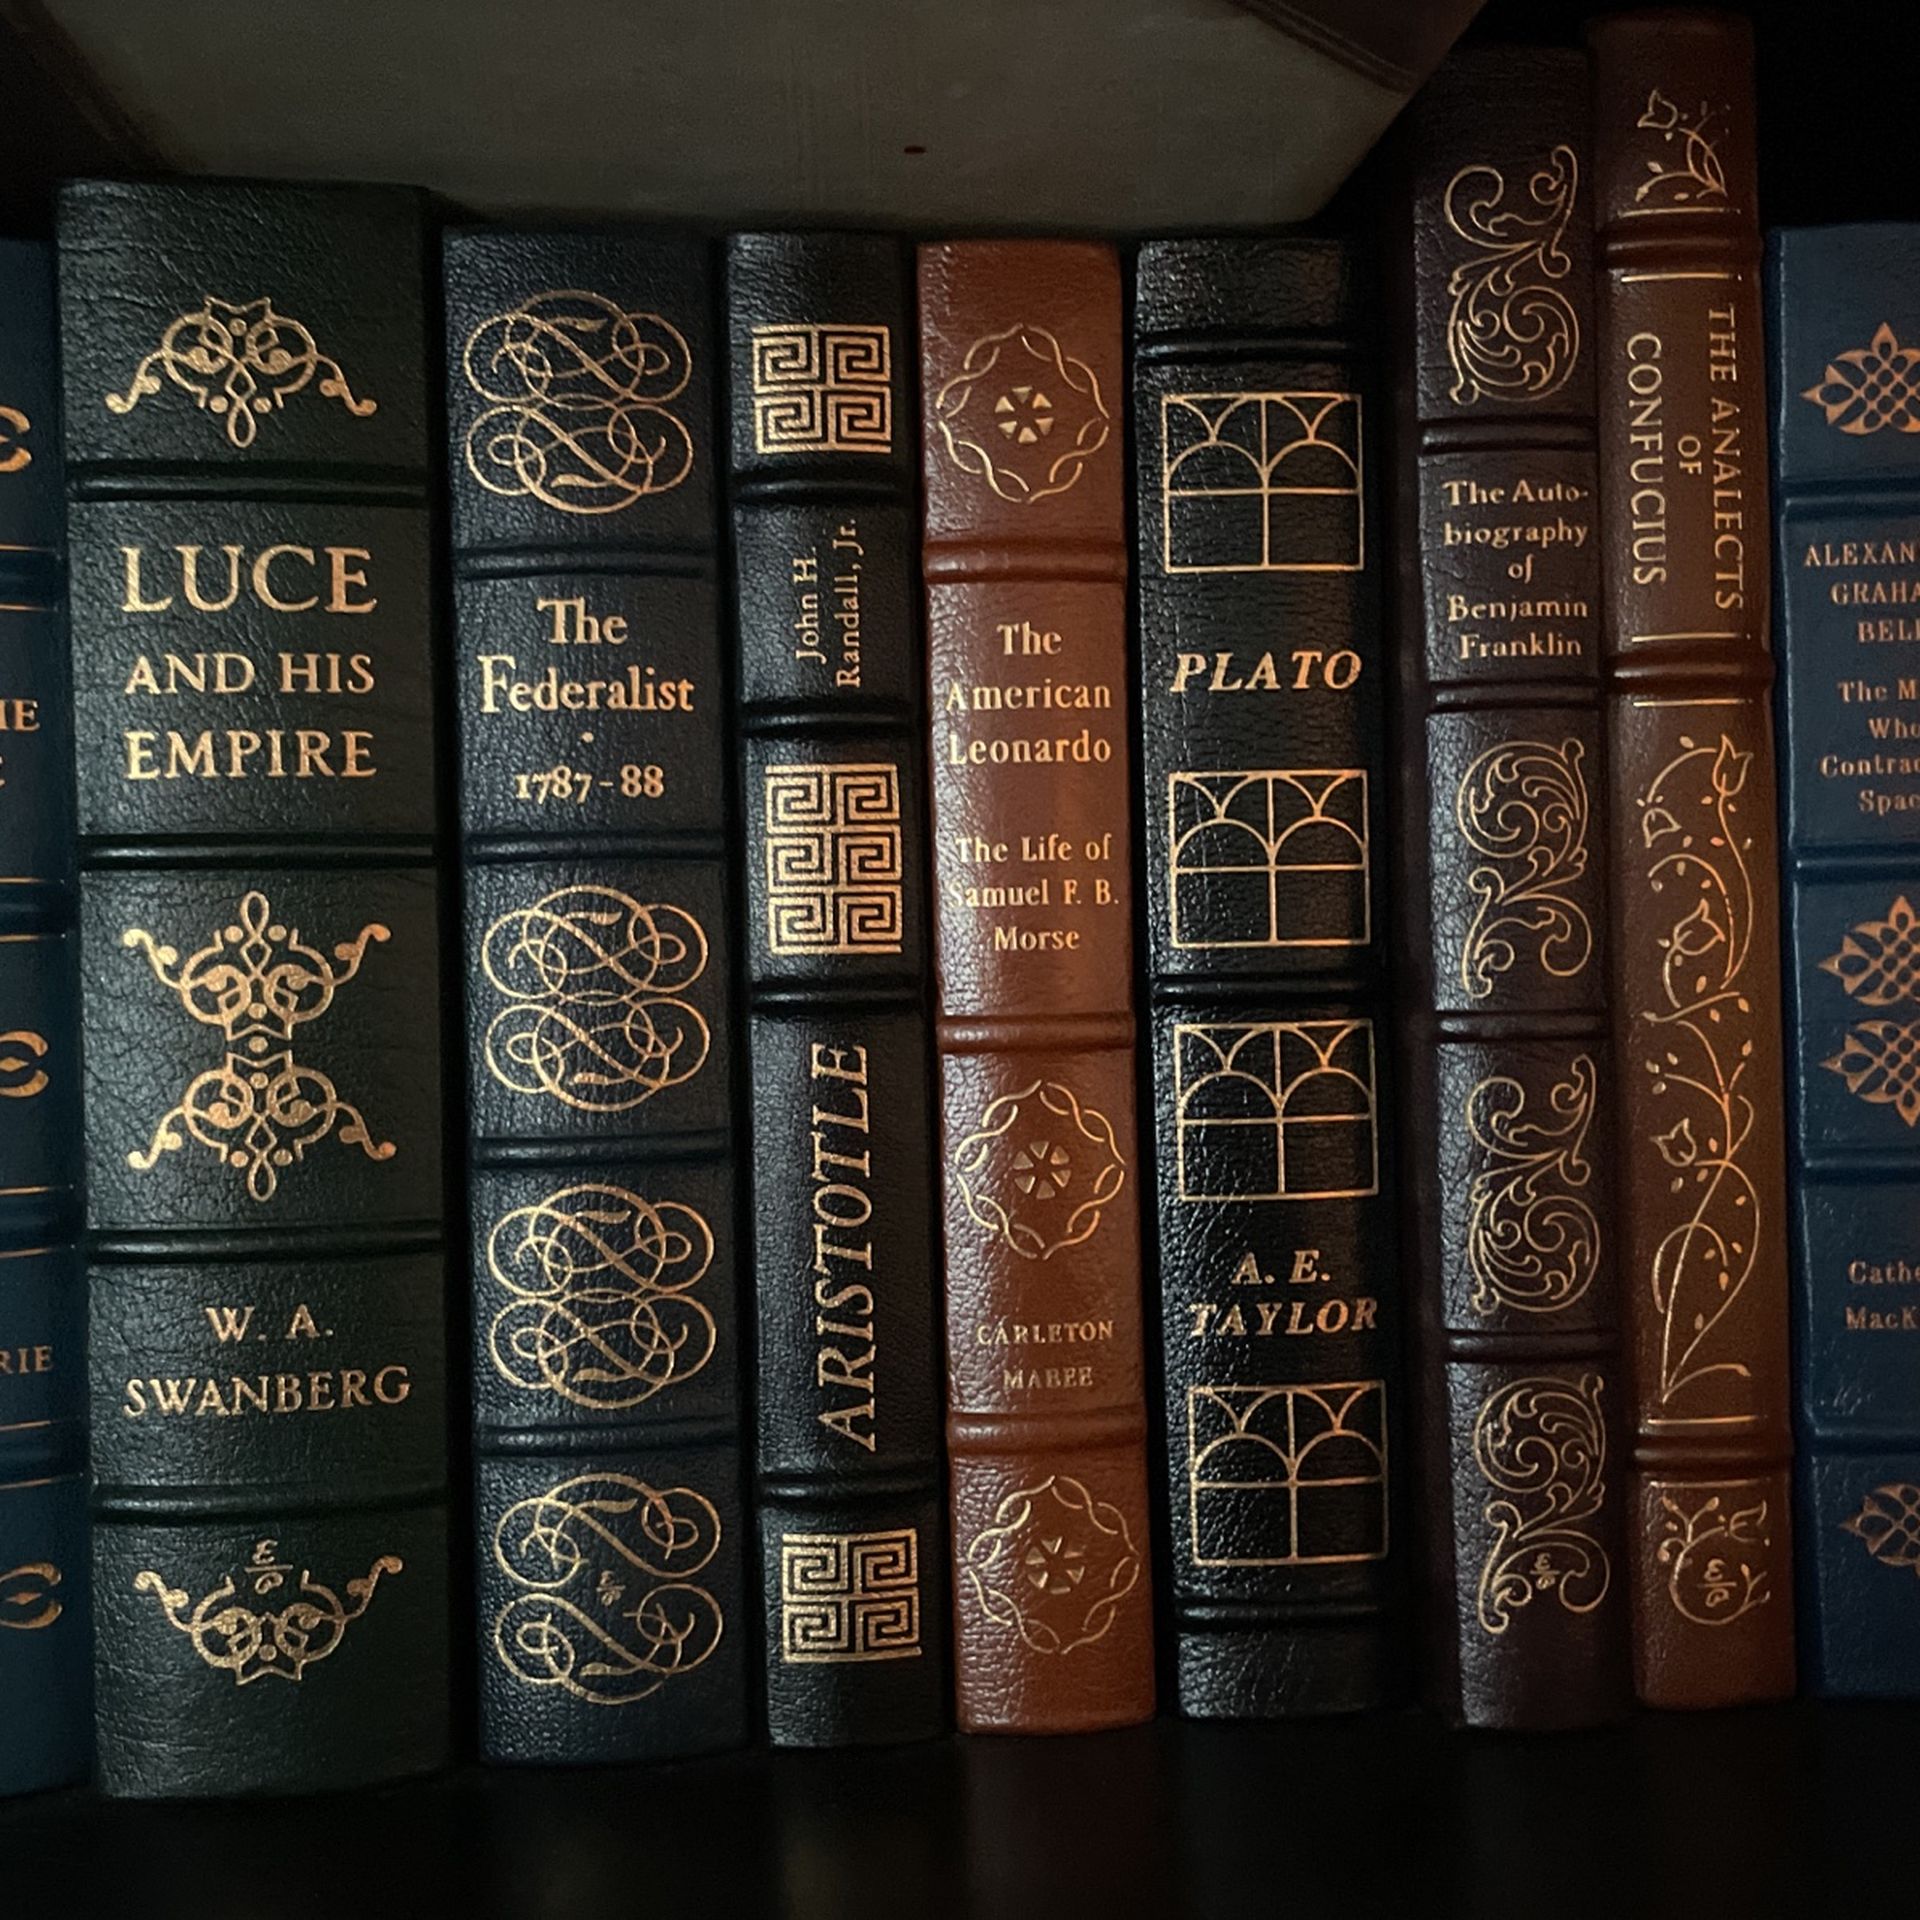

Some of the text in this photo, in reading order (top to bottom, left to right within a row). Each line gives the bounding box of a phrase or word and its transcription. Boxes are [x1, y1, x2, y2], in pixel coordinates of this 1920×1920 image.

[1626, 332, 1667, 586] CONFUCIUS
[1677, 434, 1702, 475] OF
[1708, 306, 1744, 611] THE ANALECTS
[1441, 479, 1589, 506] The Auto-
[1443, 517, 1588, 549] biography
[121, 544, 378, 613] LUCE
[1507, 553, 1534, 584] of
[536, 596, 628, 645] The
[792, 547, 827, 665] John H.
[832, 518, 865, 688] Randall, Jr.
[1447, 594, 1588, 623] Benjamin
[997, 622, 1062, 656] The
[1459, 631, 1583, 660] Franklin
[123, 653, 375, 695] AND HIS
[476, 654, 695, 714] Federalist
[1168, 650, 1363, 693] PLATO
[1837, 678, 1888, 703] The
[945, 678, 1112, 713] American
[122, 730, 377, 780] EMPIRE
[947, 729, 1112, 765] Leonardo
[955, 833, 1112, 865] The Life of
[947, 878, 1120, 908] Samuel F. B.
[993, 925, 1081, 952] Morse
[809, 1042, 877, 1453] ARISTOTLE
[1230, 1248, 1332, 1287] A. E.
[204, 1303, 334, 1344] W. A.
[976, 1319, 1114, 1346] CARLETON
[1187, 1298, 1378, 1339] TAYLOR
[122, 1365, 411, 1418] SWANBERG
[1003, 1365, 1094, 1390] MABEE
